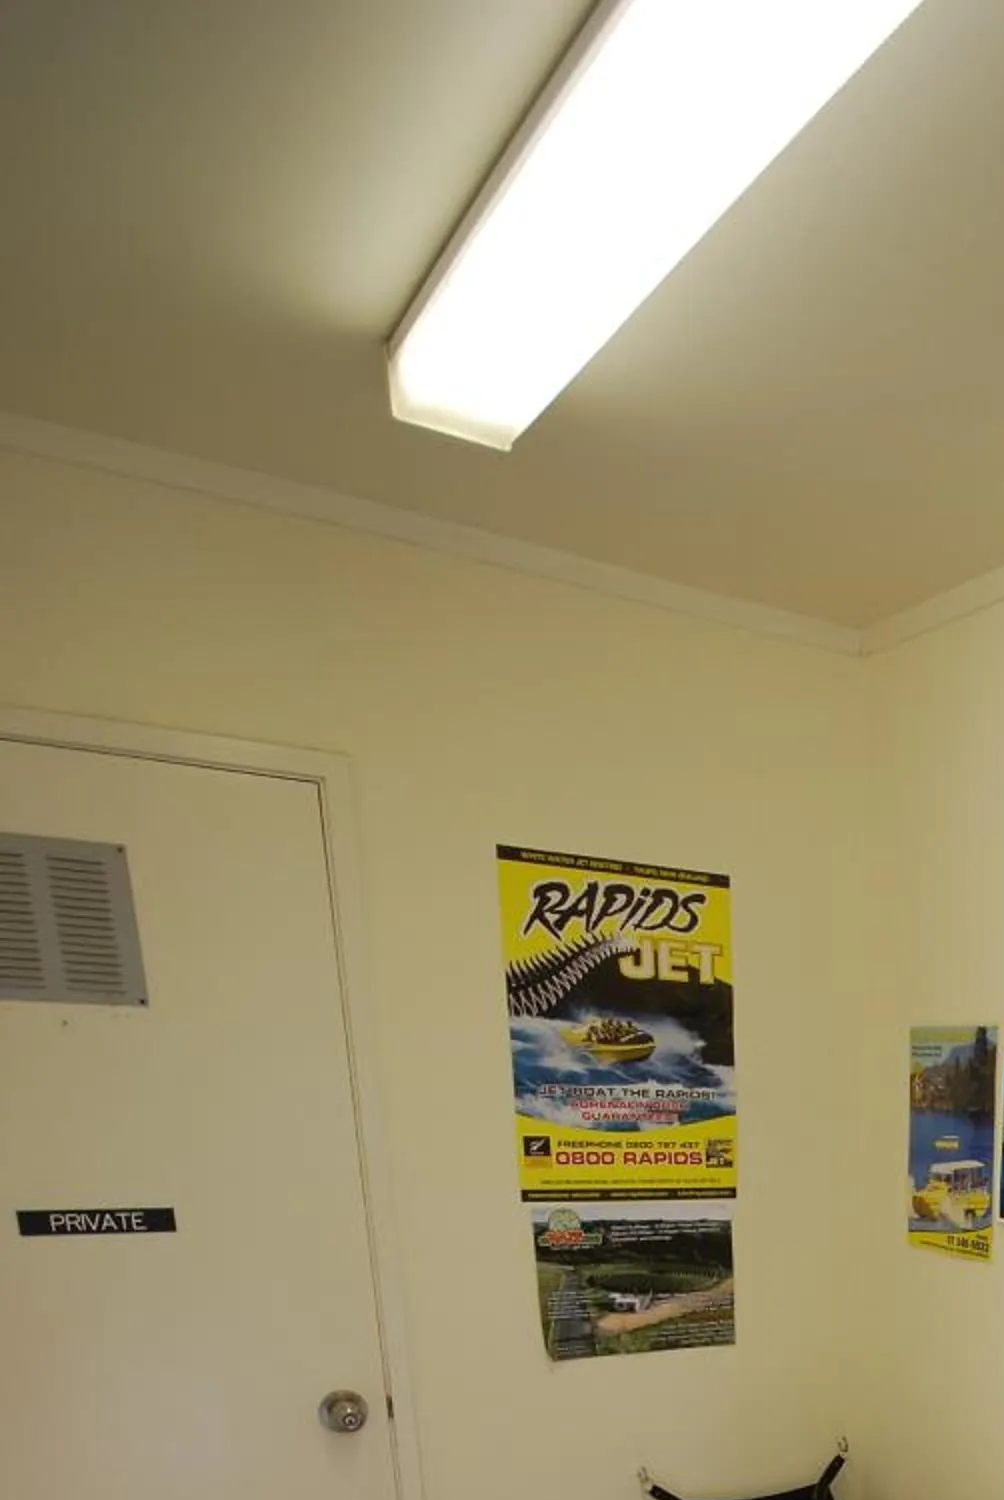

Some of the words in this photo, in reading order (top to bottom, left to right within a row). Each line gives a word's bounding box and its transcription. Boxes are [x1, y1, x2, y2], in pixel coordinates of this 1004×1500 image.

[618, 937, 724, 984] JET
[621, 1087, 650, 1098] THE
[555, 1151, 615, 1165] 0800
[623, 1151, 704, 1166] RAPIDS
[50, 1212, 147, 1232] PRIVATE
